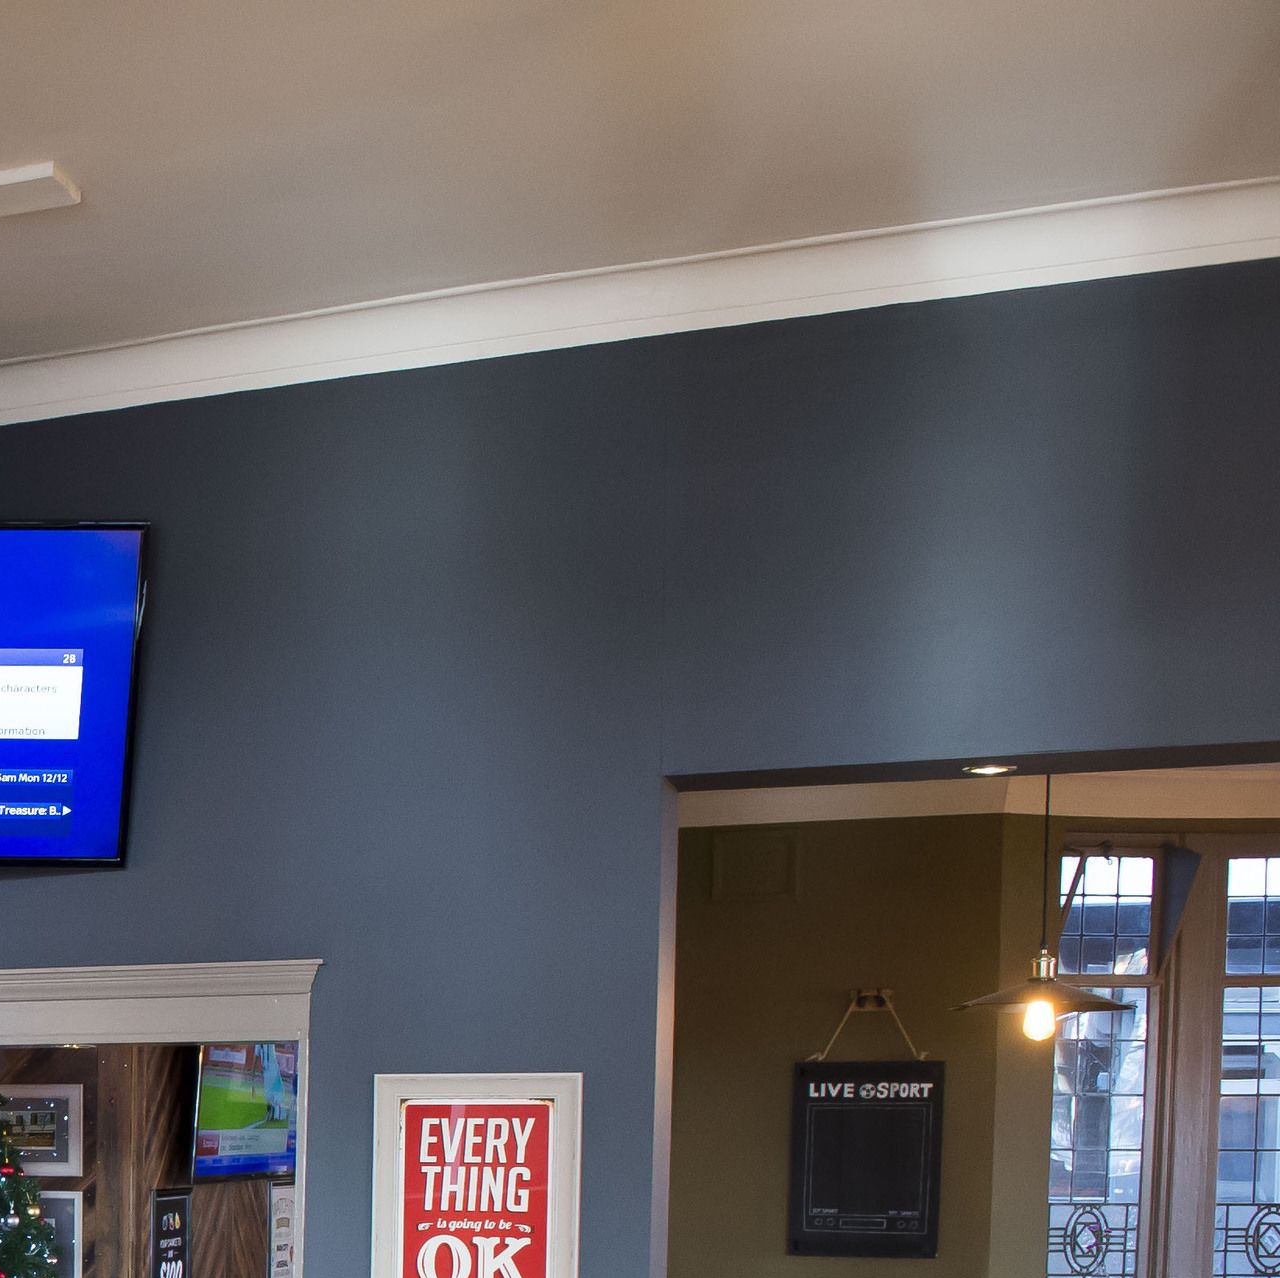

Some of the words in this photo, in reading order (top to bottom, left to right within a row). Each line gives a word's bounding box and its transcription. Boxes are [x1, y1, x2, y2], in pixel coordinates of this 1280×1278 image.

[63, 653, 77, 664] 28
[1, 684, 57, 694] characters
[18, 773, 40, 783] Mon
[42, 773, 68, 783] 12/12
[809, 1083, 855, 1098] LIVE
[876, 1082, 934, 1098] SPORT
[419, 1117, 536, 1164] EVERY
[421, 1166, 532, 1213] THING
[436, 1218, 447, 1229] is
[448, 1218, 482, 1232] going
[484, 1219, 497, 1230] to
[498, 1218, 513, 1231] be
